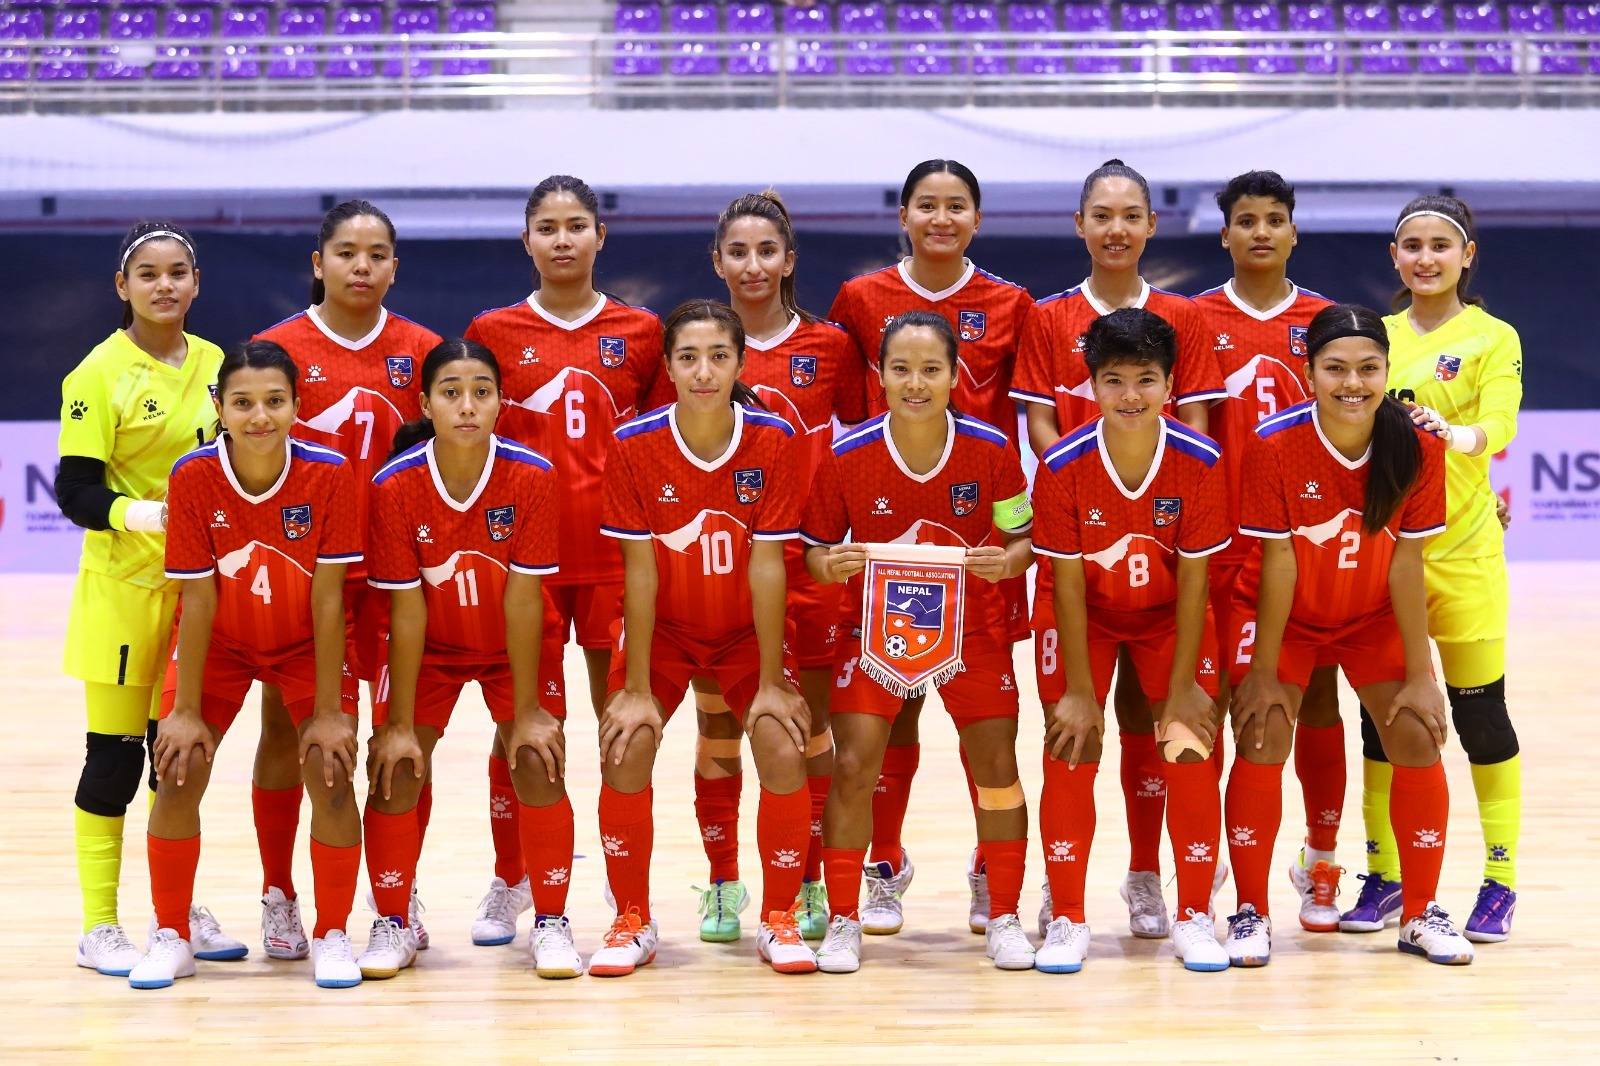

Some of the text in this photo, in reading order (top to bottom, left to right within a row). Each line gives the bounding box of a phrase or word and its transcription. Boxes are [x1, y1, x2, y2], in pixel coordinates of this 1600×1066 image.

[519, 357, 541, 365] KELME
[143, 411, 167, 421] KELME
[564, 391, 586, 439] 6
[1256, 377, 1277, 421] 5
[355, 411, 375, 460] 7
[699, 532, 734, 577] 10
[1337, 531, 1361, 569] 2
[250, 565, 272, 605] 4
[454, 568, 479, 607] 11
[877, 568, 886, 577] ALL
[901, 570, 925, 580] FOOTBALL
[925, 571, 956, 582] ASSOCIATION
[1127, 553, 1150, 588] 8
[897, 585, 932, 596] NEPAL
[1041, 628, 1058, 675] 8
[1235, 621, 1257, 664] 2
[117, 644, 129, 686] 1
[1185, 855, 1213, 863] KELME
[1412, 841, 1443, 849] KELME
[543, 878, 569, 886] KELM
[771, 860, 801, 869] KELME
[375, 880, 404, 888] KELME
